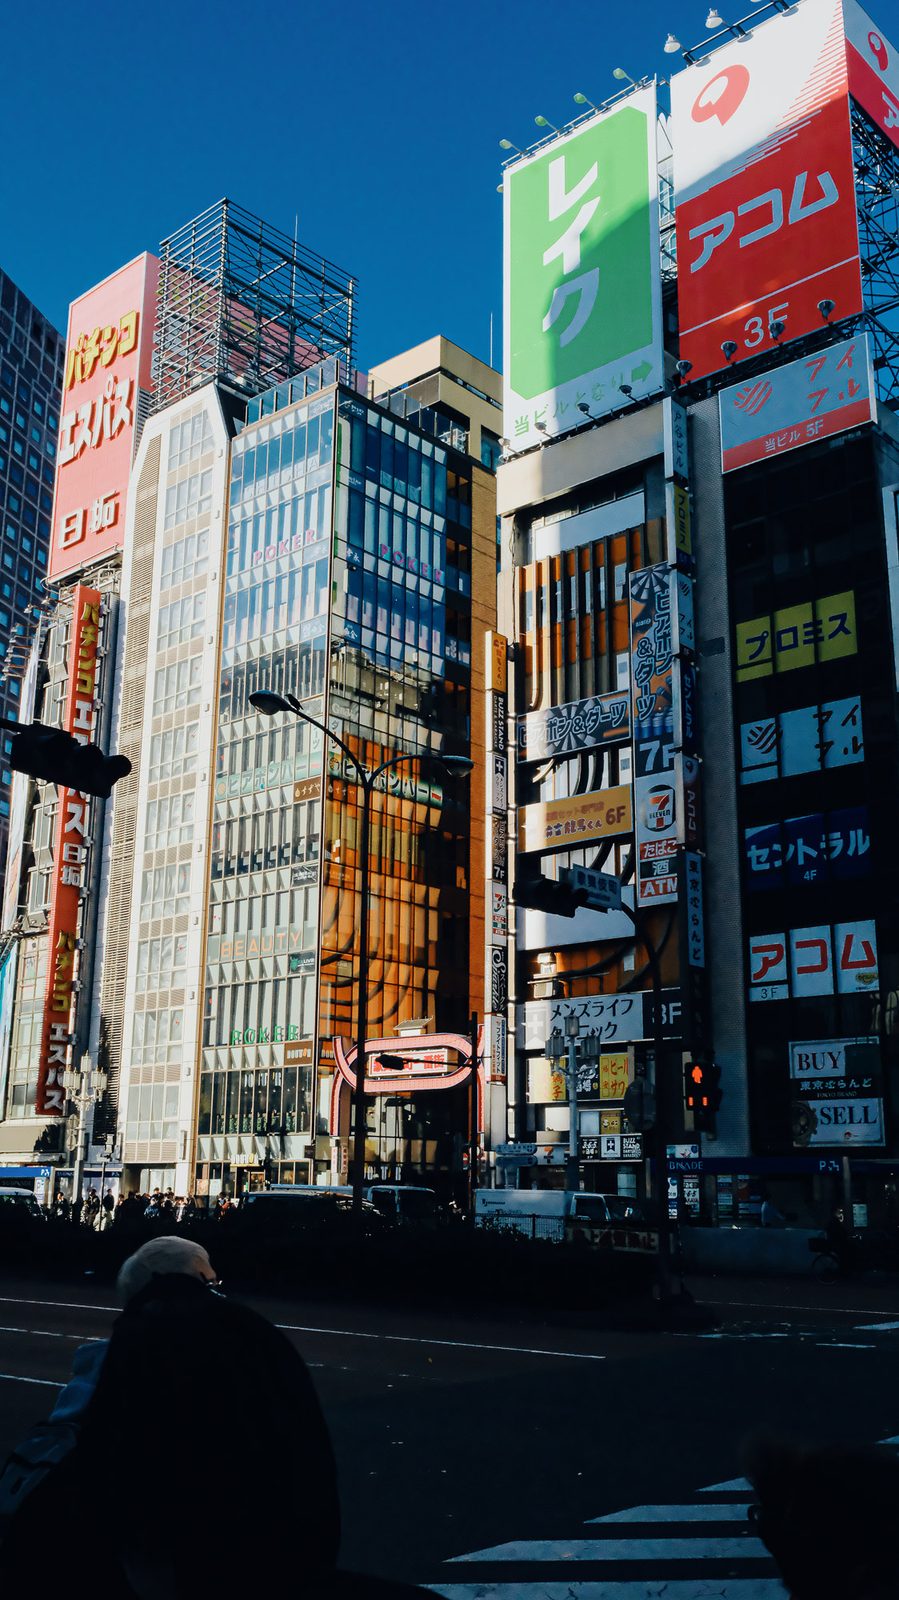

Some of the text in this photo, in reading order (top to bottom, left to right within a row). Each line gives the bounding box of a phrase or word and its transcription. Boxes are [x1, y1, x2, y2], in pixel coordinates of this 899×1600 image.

[689, 170, 839, 273] アコム
[543, 155, 600, 347] レイク
[744, 301, 790, 348] 3F
[66, 309, 137, 391] パチンコ
[59, 373, 134, 464] エスパス
[514, 371, 625, 438] 当ビルとなり
[764, 419, 824, 452] 当ビル 5F
[59, 489, 120, 549] 日拓
[254, 529, 316, 566] POKER
[380, 543, 444, 583] POKER
[75, 601, 99, 694] パチンコ
[746, 612, 852, 660] プロミス
[639, 740, 675, 771] 7F
[605, 805, 626, 826] 6F
[644, 839, 678, 858] たばこ
[652, 859, 669, 876] 酒
[747, 828, 871, 872] セントラル
[494, 866, 505, 878] 7F
[803, 870, 817, 881] 4F
[220, 931, 303, 959] BEAUTY
[751, 934, 877, 980] アコム
[52, 930, 76, 1012] パチンコ
[550, 998, 634, 1021] メンズライフ
[761, 987, 778, 999] 3F
[231, 1023, 298, 1046] POKER
[43, 1022, 70, 1111] エスパス
[797, 1051, 841, 1071] BUY
[820, 1105, 877, 1125] SELL
